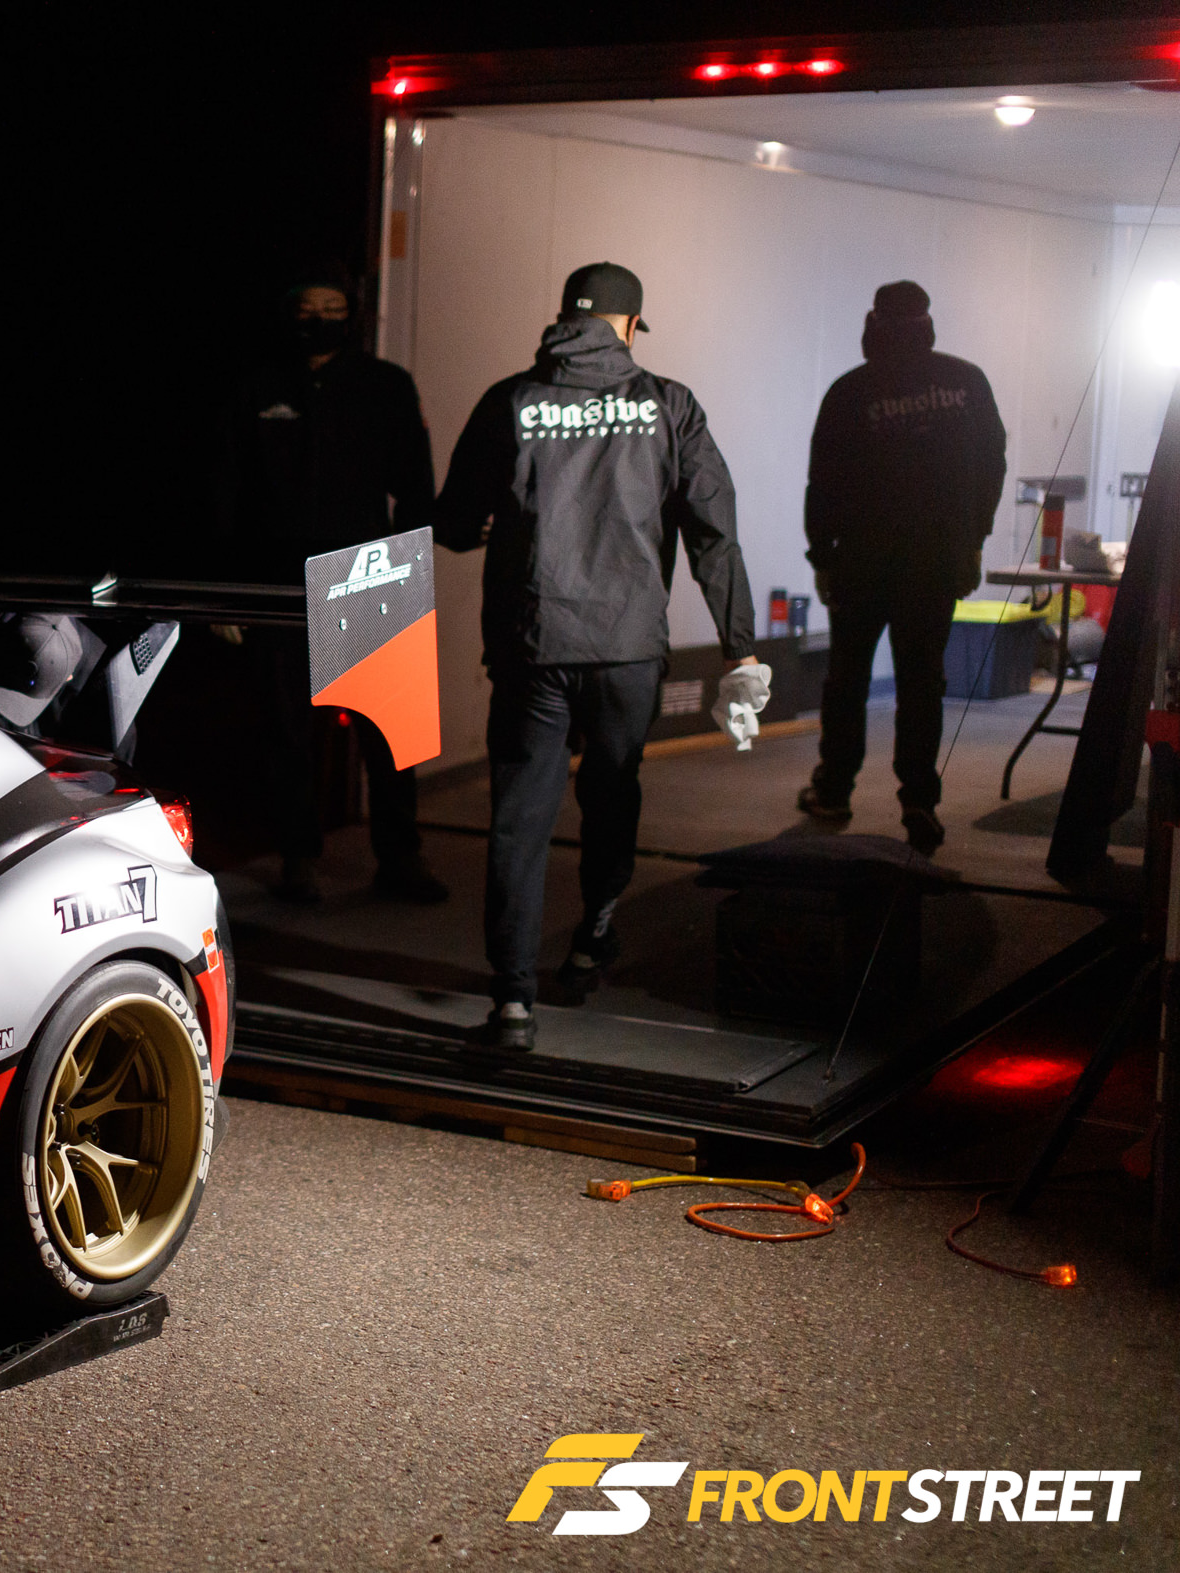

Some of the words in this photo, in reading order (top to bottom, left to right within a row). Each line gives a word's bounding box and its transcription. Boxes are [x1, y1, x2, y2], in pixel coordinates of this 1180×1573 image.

[520, 394, 658, 429] evasive
[326, 586, 347, 601] APR
[347, 564, 411, 596] PERFORMANCE
[157, 977, 208, 1057] TOYO
[197, 1062, 215, 1184] TIRES
